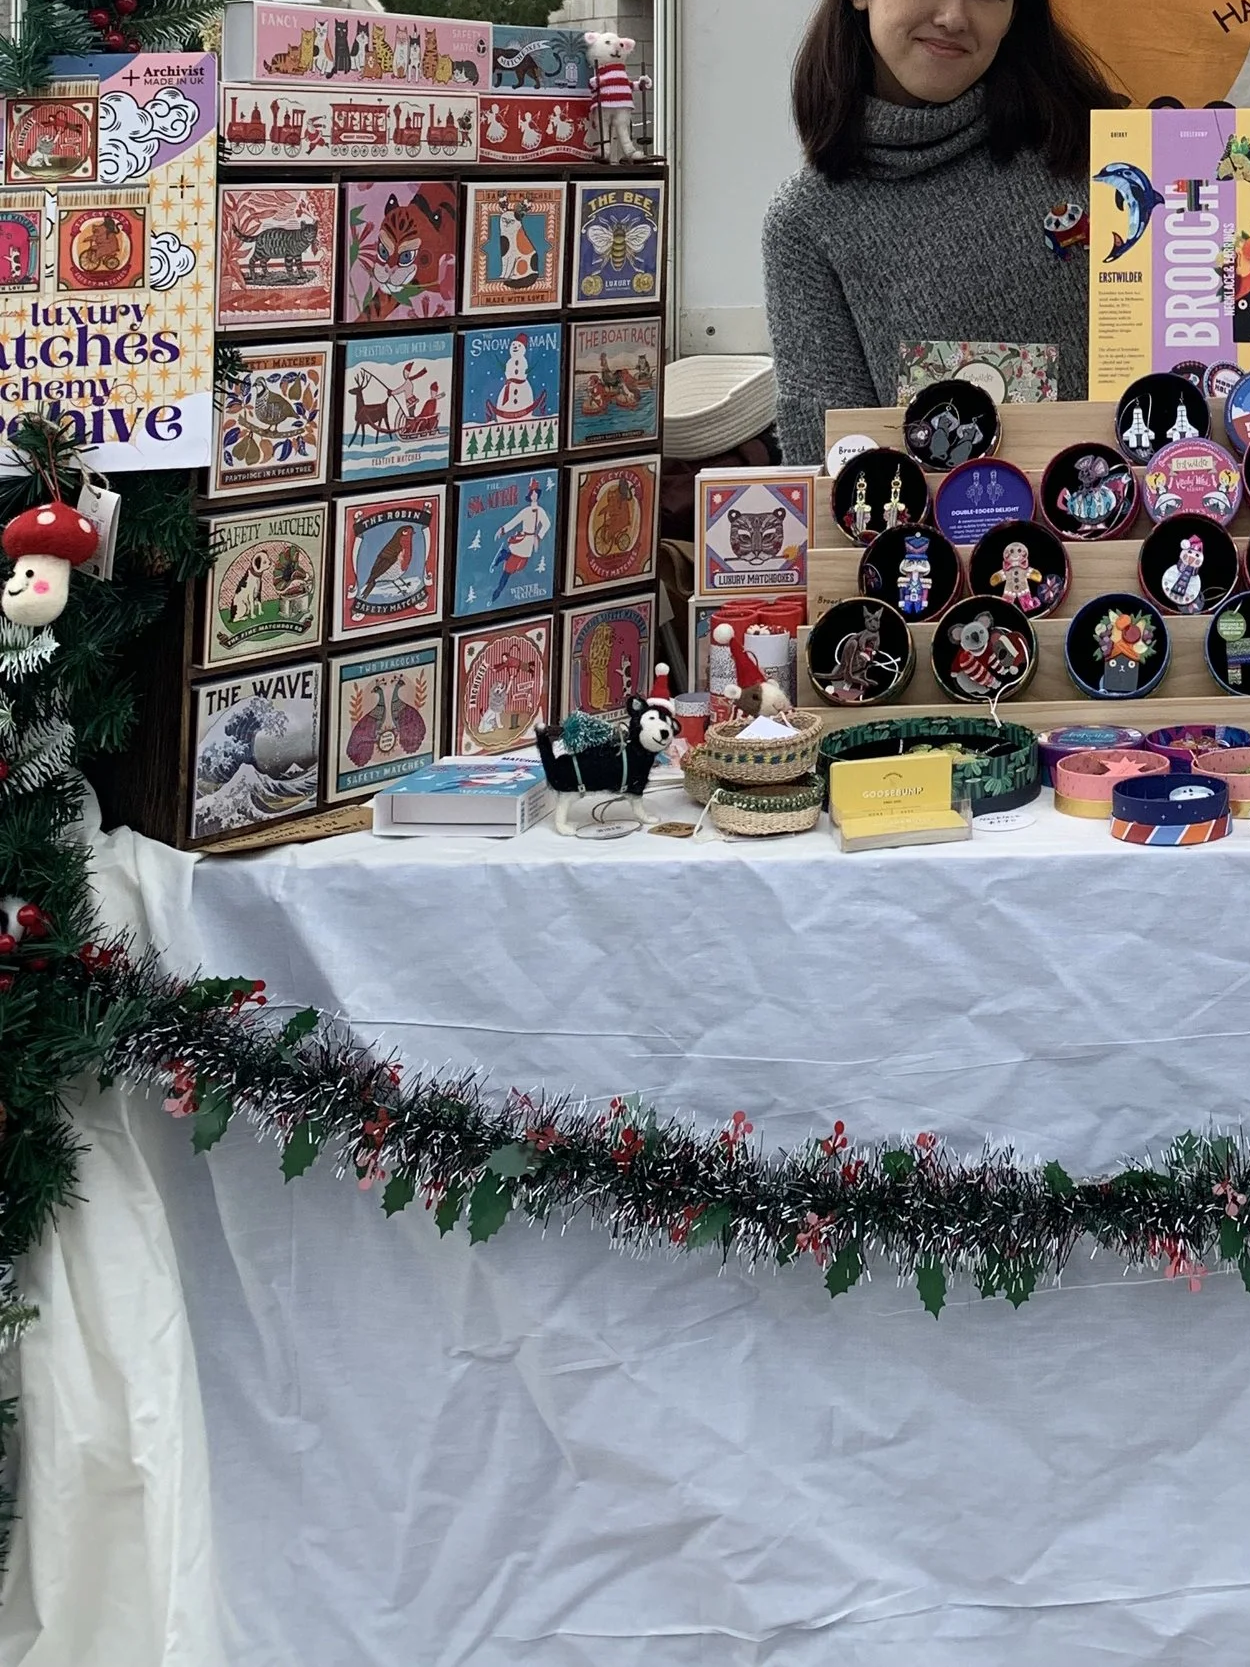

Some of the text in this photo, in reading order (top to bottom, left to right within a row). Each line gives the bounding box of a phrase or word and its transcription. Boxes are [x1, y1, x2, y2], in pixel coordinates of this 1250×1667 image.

[261, 12, 300, 28] FANCY
[143, 65, 205, 77] Archivist
[143, 77, 204, 86] MADE IN UK
[588, 191, 654, 212] THE BEE
[1164, 185, 1220, 348] BROOCH
[1223, 222, 1236, 316] NECKLACE & EARRINGS
[605, 279, 631, 288] LUXURY
[1098, 271, 1143, 283] ERSTWILDER
[31, 302, 151, 332] luxury
[470, 332, 559, 357] SNOW MAN
[578, 326, 656, 353] THE BOAT RACE
[272, 356, 316, 368] MATCHES
[607, 470, 641, 489] CYCLIST
[467, 485, 520, 517] SKATER
[995, 506, 1019, 514] DELIGHT
[362, 510, 421, 529] THE ROBIN
[219, 514, 321, 551] SAFETY MATCHES
[718, 572, 795, 586] LUXURY MATCHBOXES
[510, 584, 540, 596] WINTER
[513, 588, 547, 601] MATCHES
[355, 589, 426, 614] SAFETY MATCHES
[227, 635, 241, 647] THE
[358, 654, 421, 675] TWO PEACOCKS
[206, 670, 313, 716] THE WAVE
[469, 661, 488, 707] ARCHIVIST
[346, 758, 425, 786] SAFETY MATCHES
[862, 786, 924, 800] GOOSEBUMP
